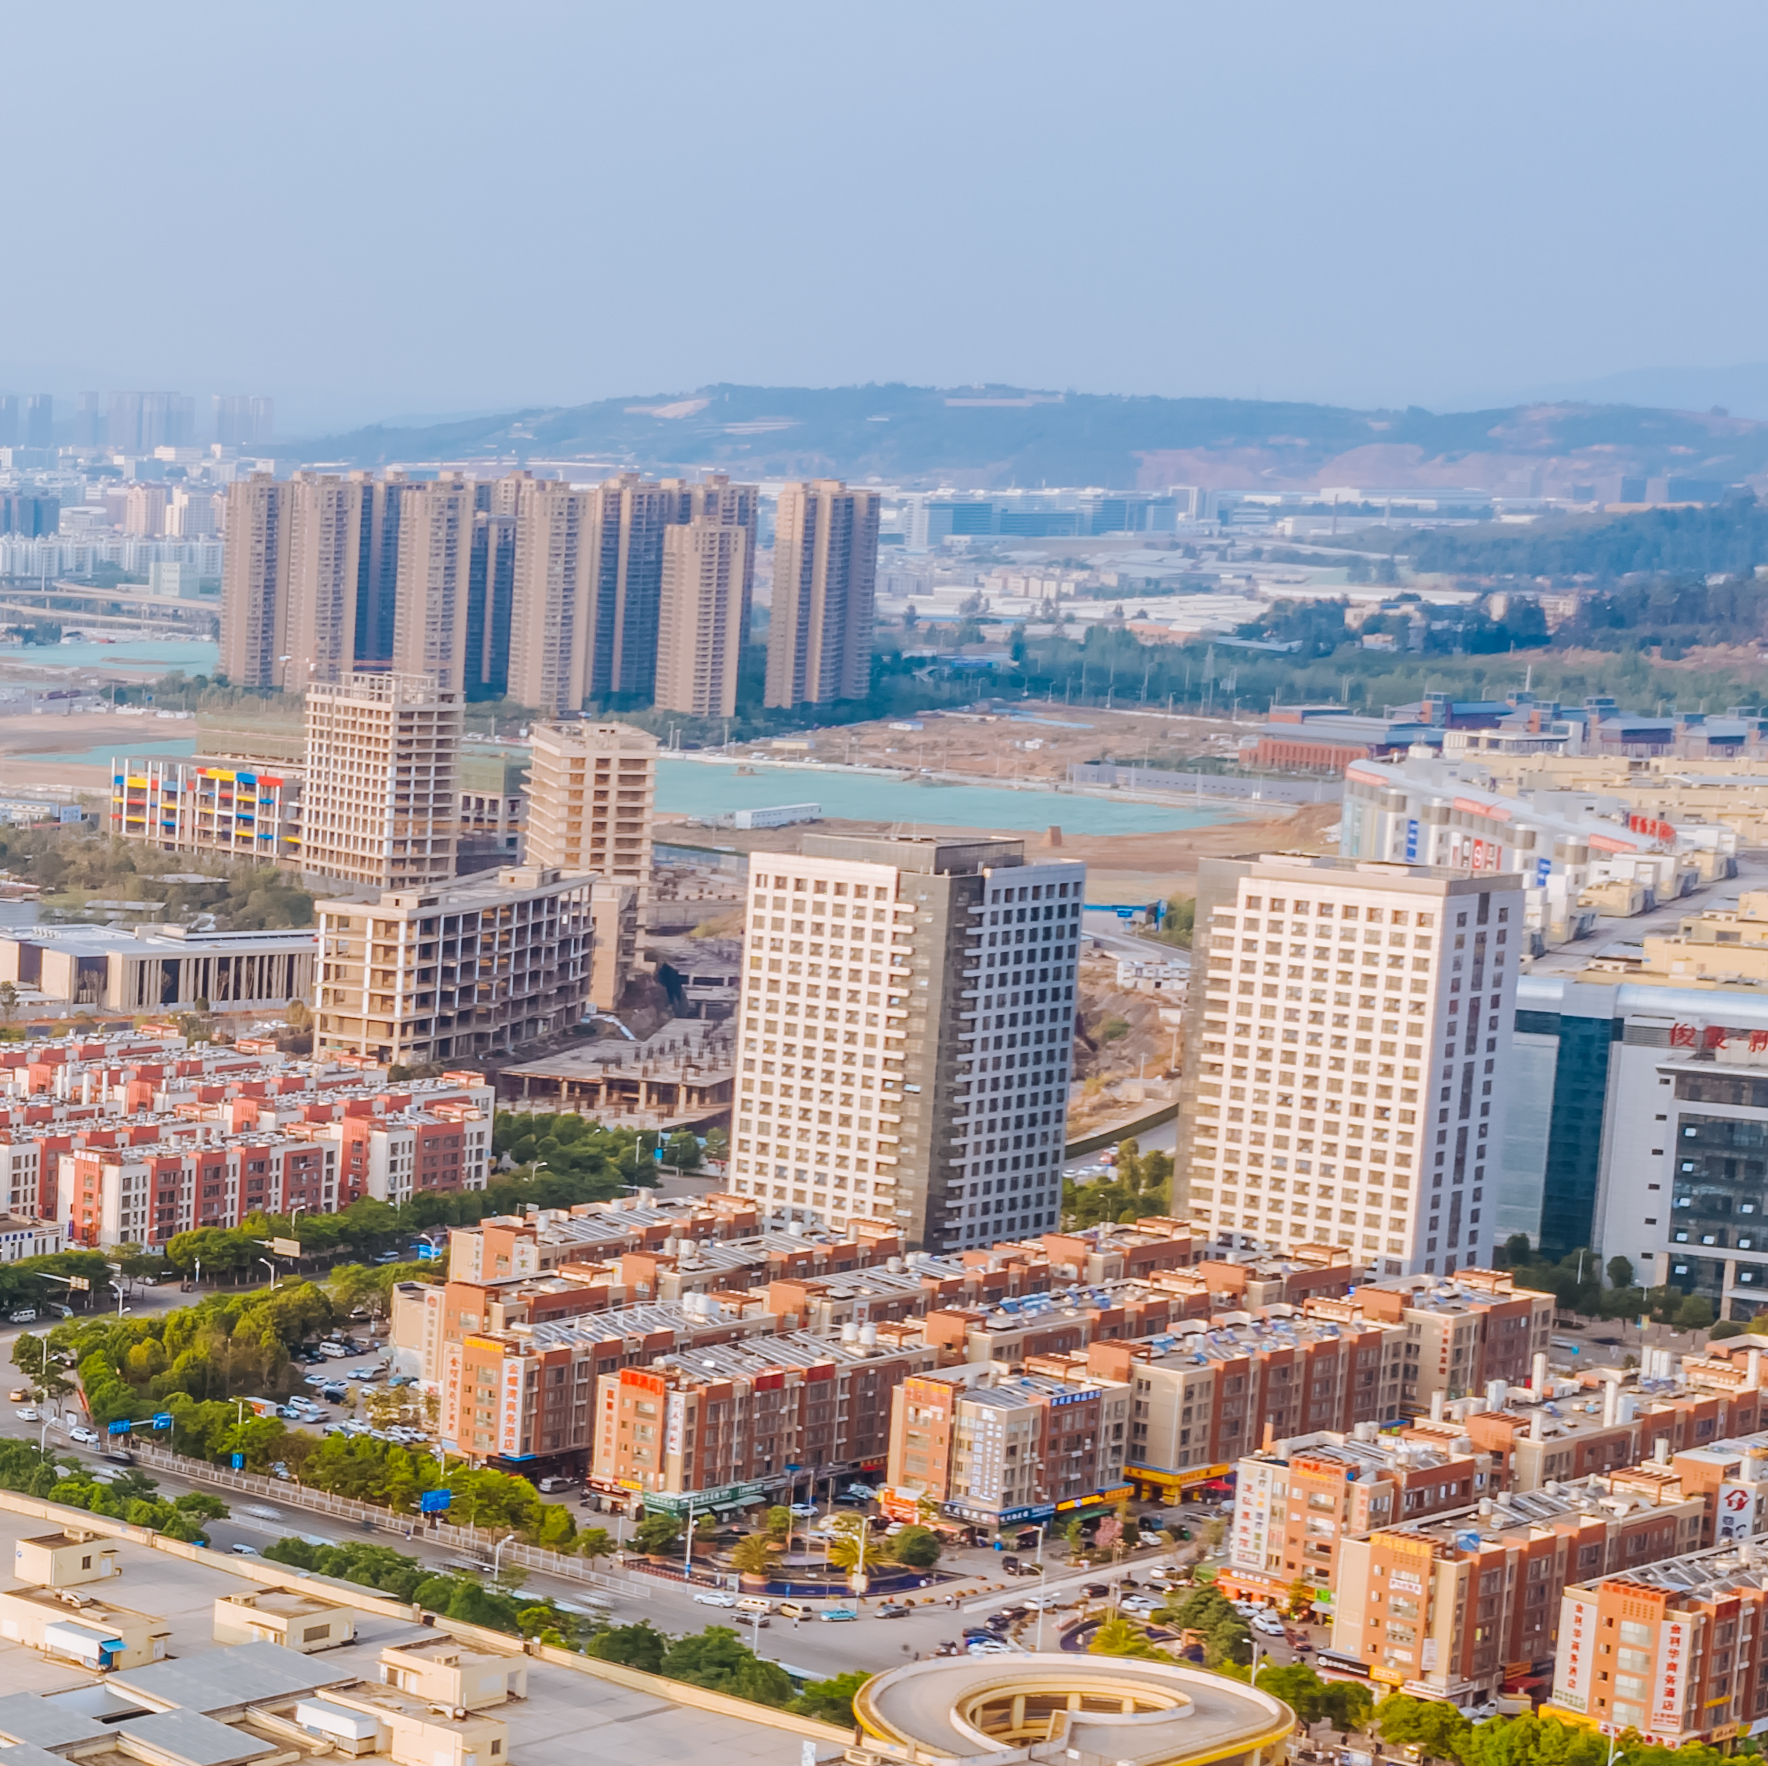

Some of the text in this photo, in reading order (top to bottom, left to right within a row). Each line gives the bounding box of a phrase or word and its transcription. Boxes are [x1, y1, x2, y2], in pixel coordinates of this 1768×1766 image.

[1568, 1602, 1584, 1690] 金利华商务酒店
[1661, 1623, 1682, 1711] 金利华商务酒店
